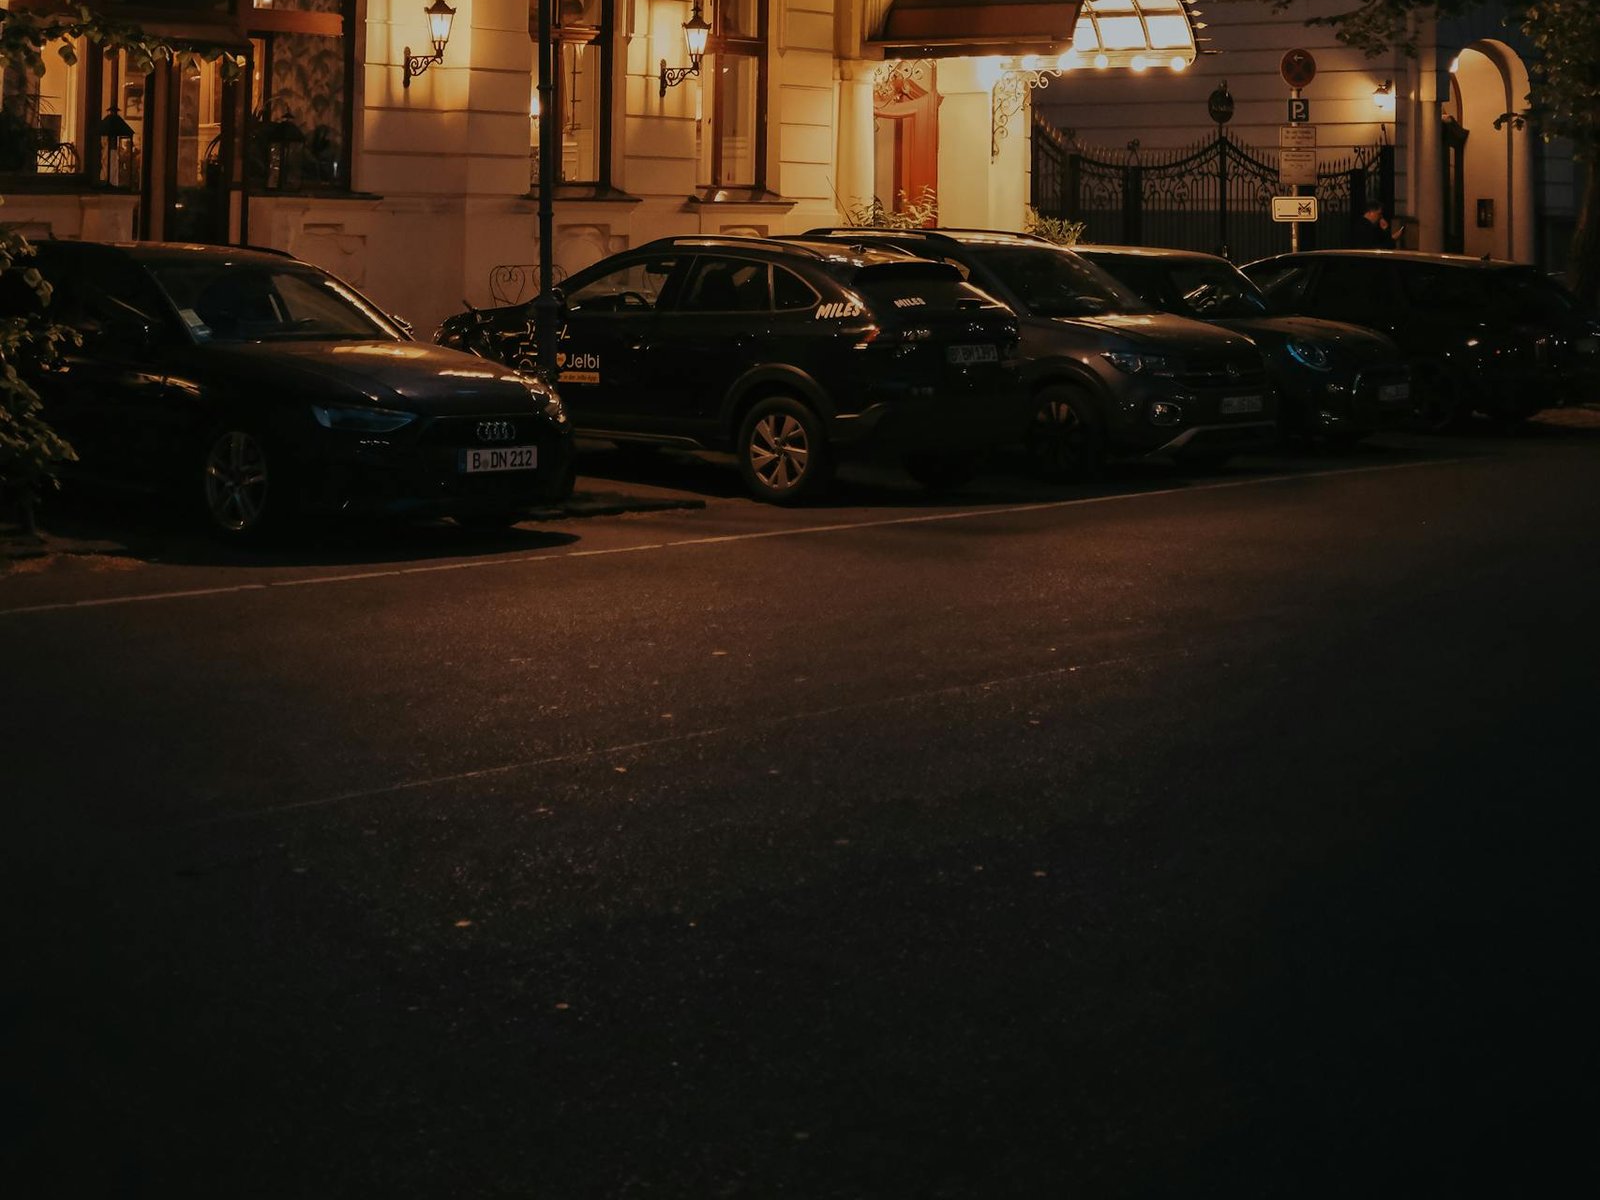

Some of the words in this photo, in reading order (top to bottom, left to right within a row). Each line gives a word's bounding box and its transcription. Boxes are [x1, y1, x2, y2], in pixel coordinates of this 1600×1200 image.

[815, 301, 862, 320] MILES
[566, 353, 600, 369] Jelbi
[472, 452, 481, 469] B
[490, 451, 507, 468] DN
[510, 449, 532, 467] 212
